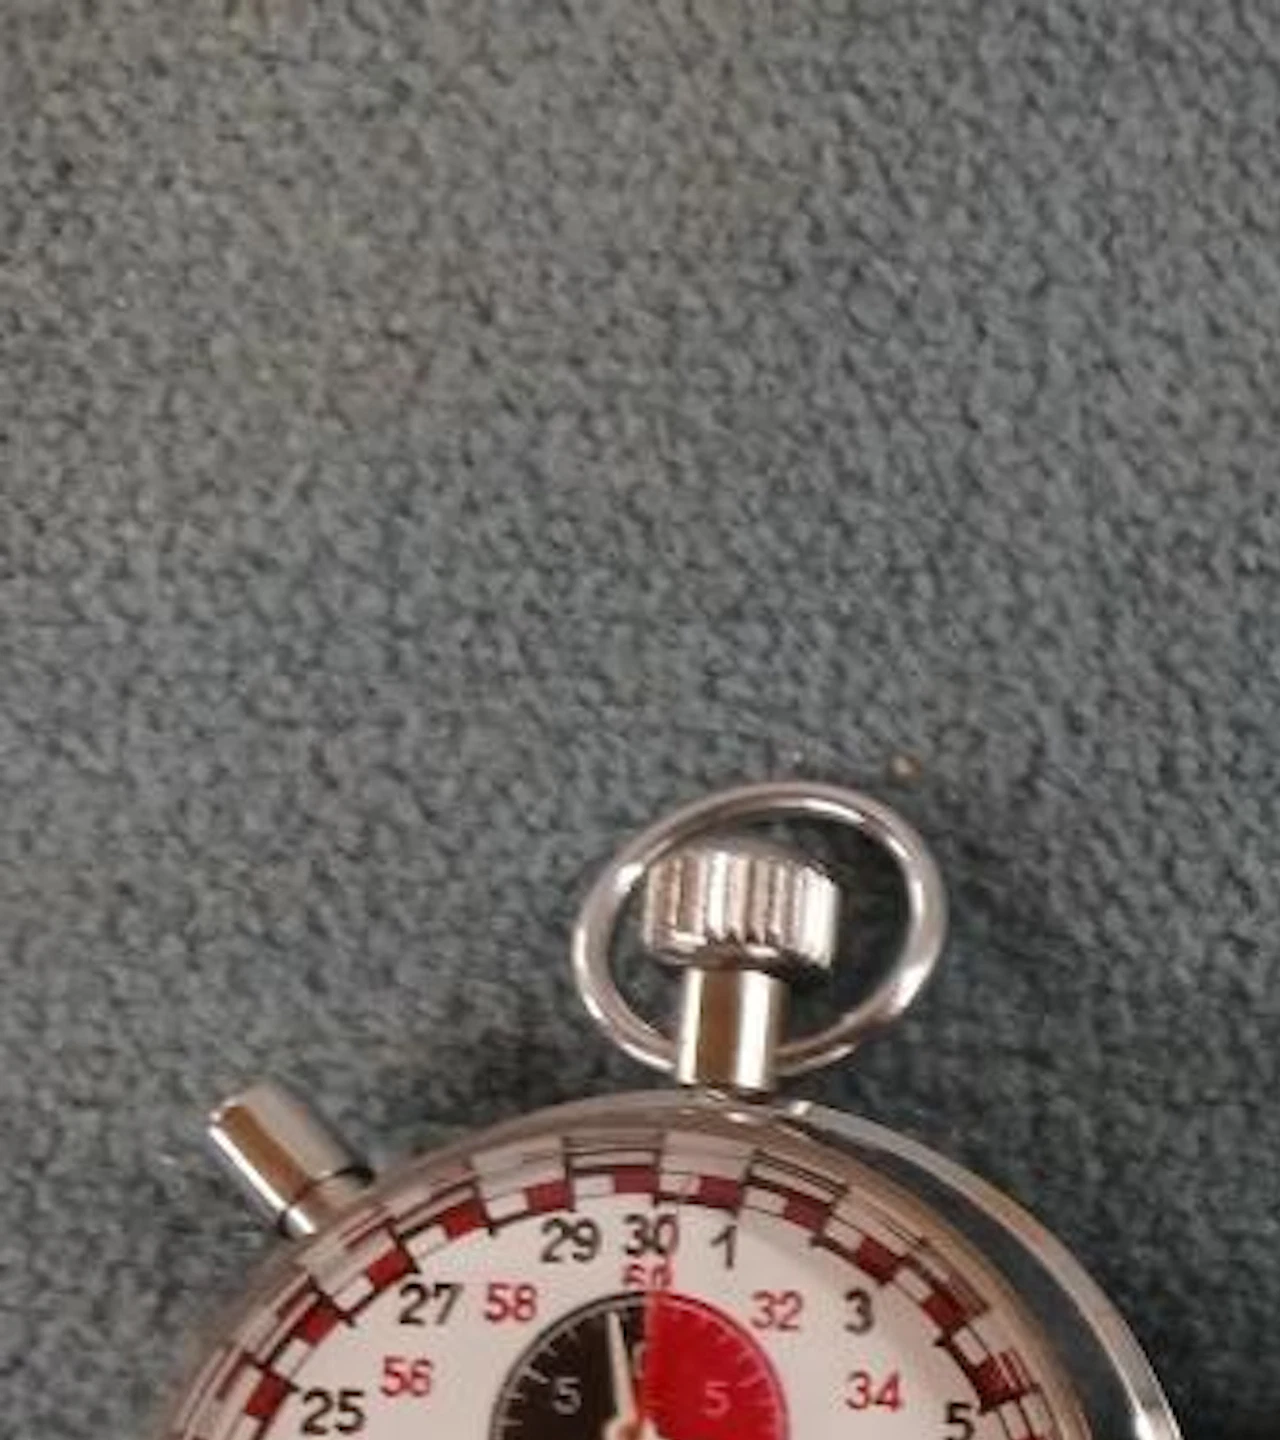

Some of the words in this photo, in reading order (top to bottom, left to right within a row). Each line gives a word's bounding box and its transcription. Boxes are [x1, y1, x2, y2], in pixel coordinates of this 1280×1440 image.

[541, 1217, 599, 1262] 29
[623, 1213, 679, 1257] 30
[710, 1225, 737, 1269] 1
[400, 1283, 462, 1325] 27
[484, 1282, 538, 1322] 58
[751, 1290, 803, 1331] 32
[844, 1288, 874, 1334] 3
[381, 1357, 433, 1397] 56
[552, 1376, 582, 1416] 5
[847, 1371, 902, 1412] 34
[301, 1390, 365, 1435] 25
[704, 1381, 731, 1417] 5
